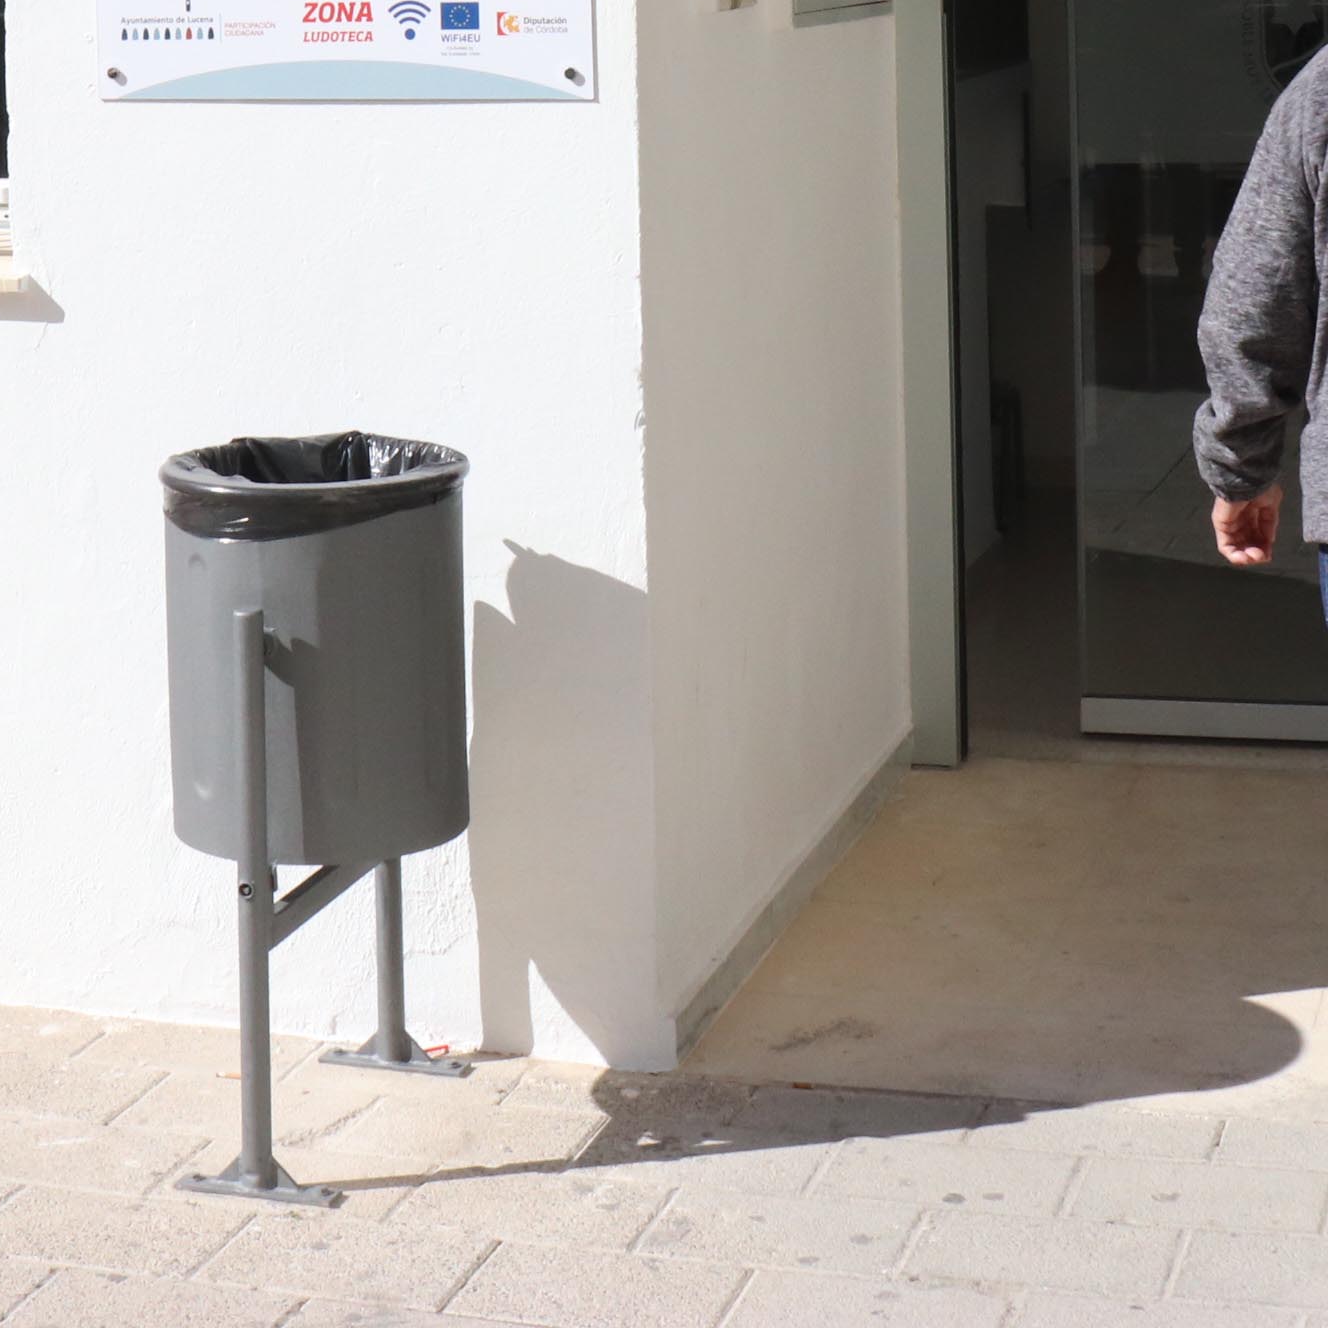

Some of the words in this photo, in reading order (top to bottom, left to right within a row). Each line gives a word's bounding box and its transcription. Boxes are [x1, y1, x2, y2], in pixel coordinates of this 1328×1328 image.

[302, 1, 374, 23] ZONA
[121, 16, 175, 25] Ayuntamiento
[177, 15, 186, 24] de
[187, 15, 214, 24] Lucena
[523, 16, 568, 26] Diputación
[523, 26, 534, 34] de
[303, 30, 374, 43] LUDOTECA
[440, 33, 481, 43] WiFi4EU
